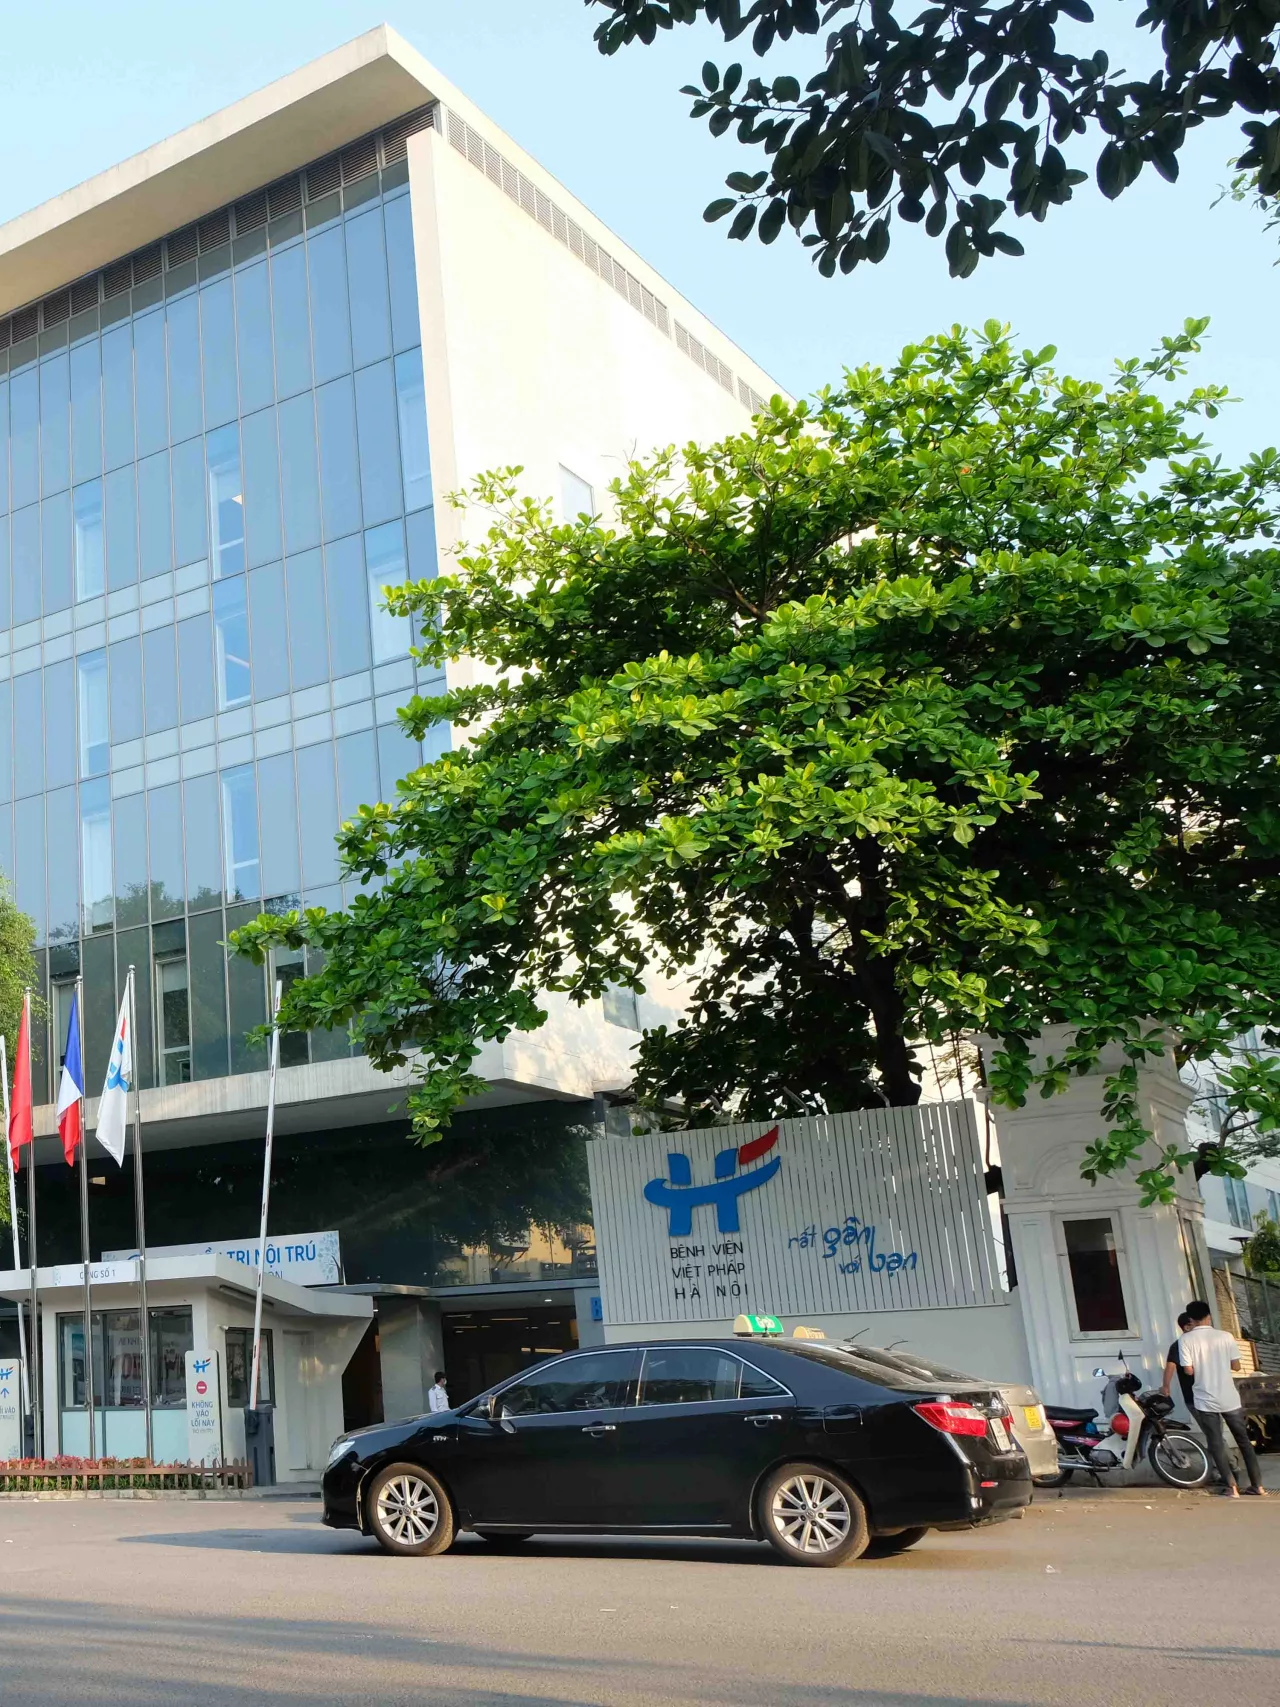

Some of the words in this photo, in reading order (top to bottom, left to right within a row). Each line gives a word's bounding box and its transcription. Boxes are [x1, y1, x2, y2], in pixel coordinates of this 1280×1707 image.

[285, 1240, 316, 1262] TRÚ
[670, 1244, 705, 1261] BỆNH
[712, 1240, 744, 1256] VIỆN
[672, 1264, 702, 1280] VIỆT
[708, 1260, 745, 1276] PHÁP
[675, 1284, 700, 1299] HÀ
[716, 1281, 748, 1298] NỘI
[191, 1400, 214, 1409] KHÔNG
